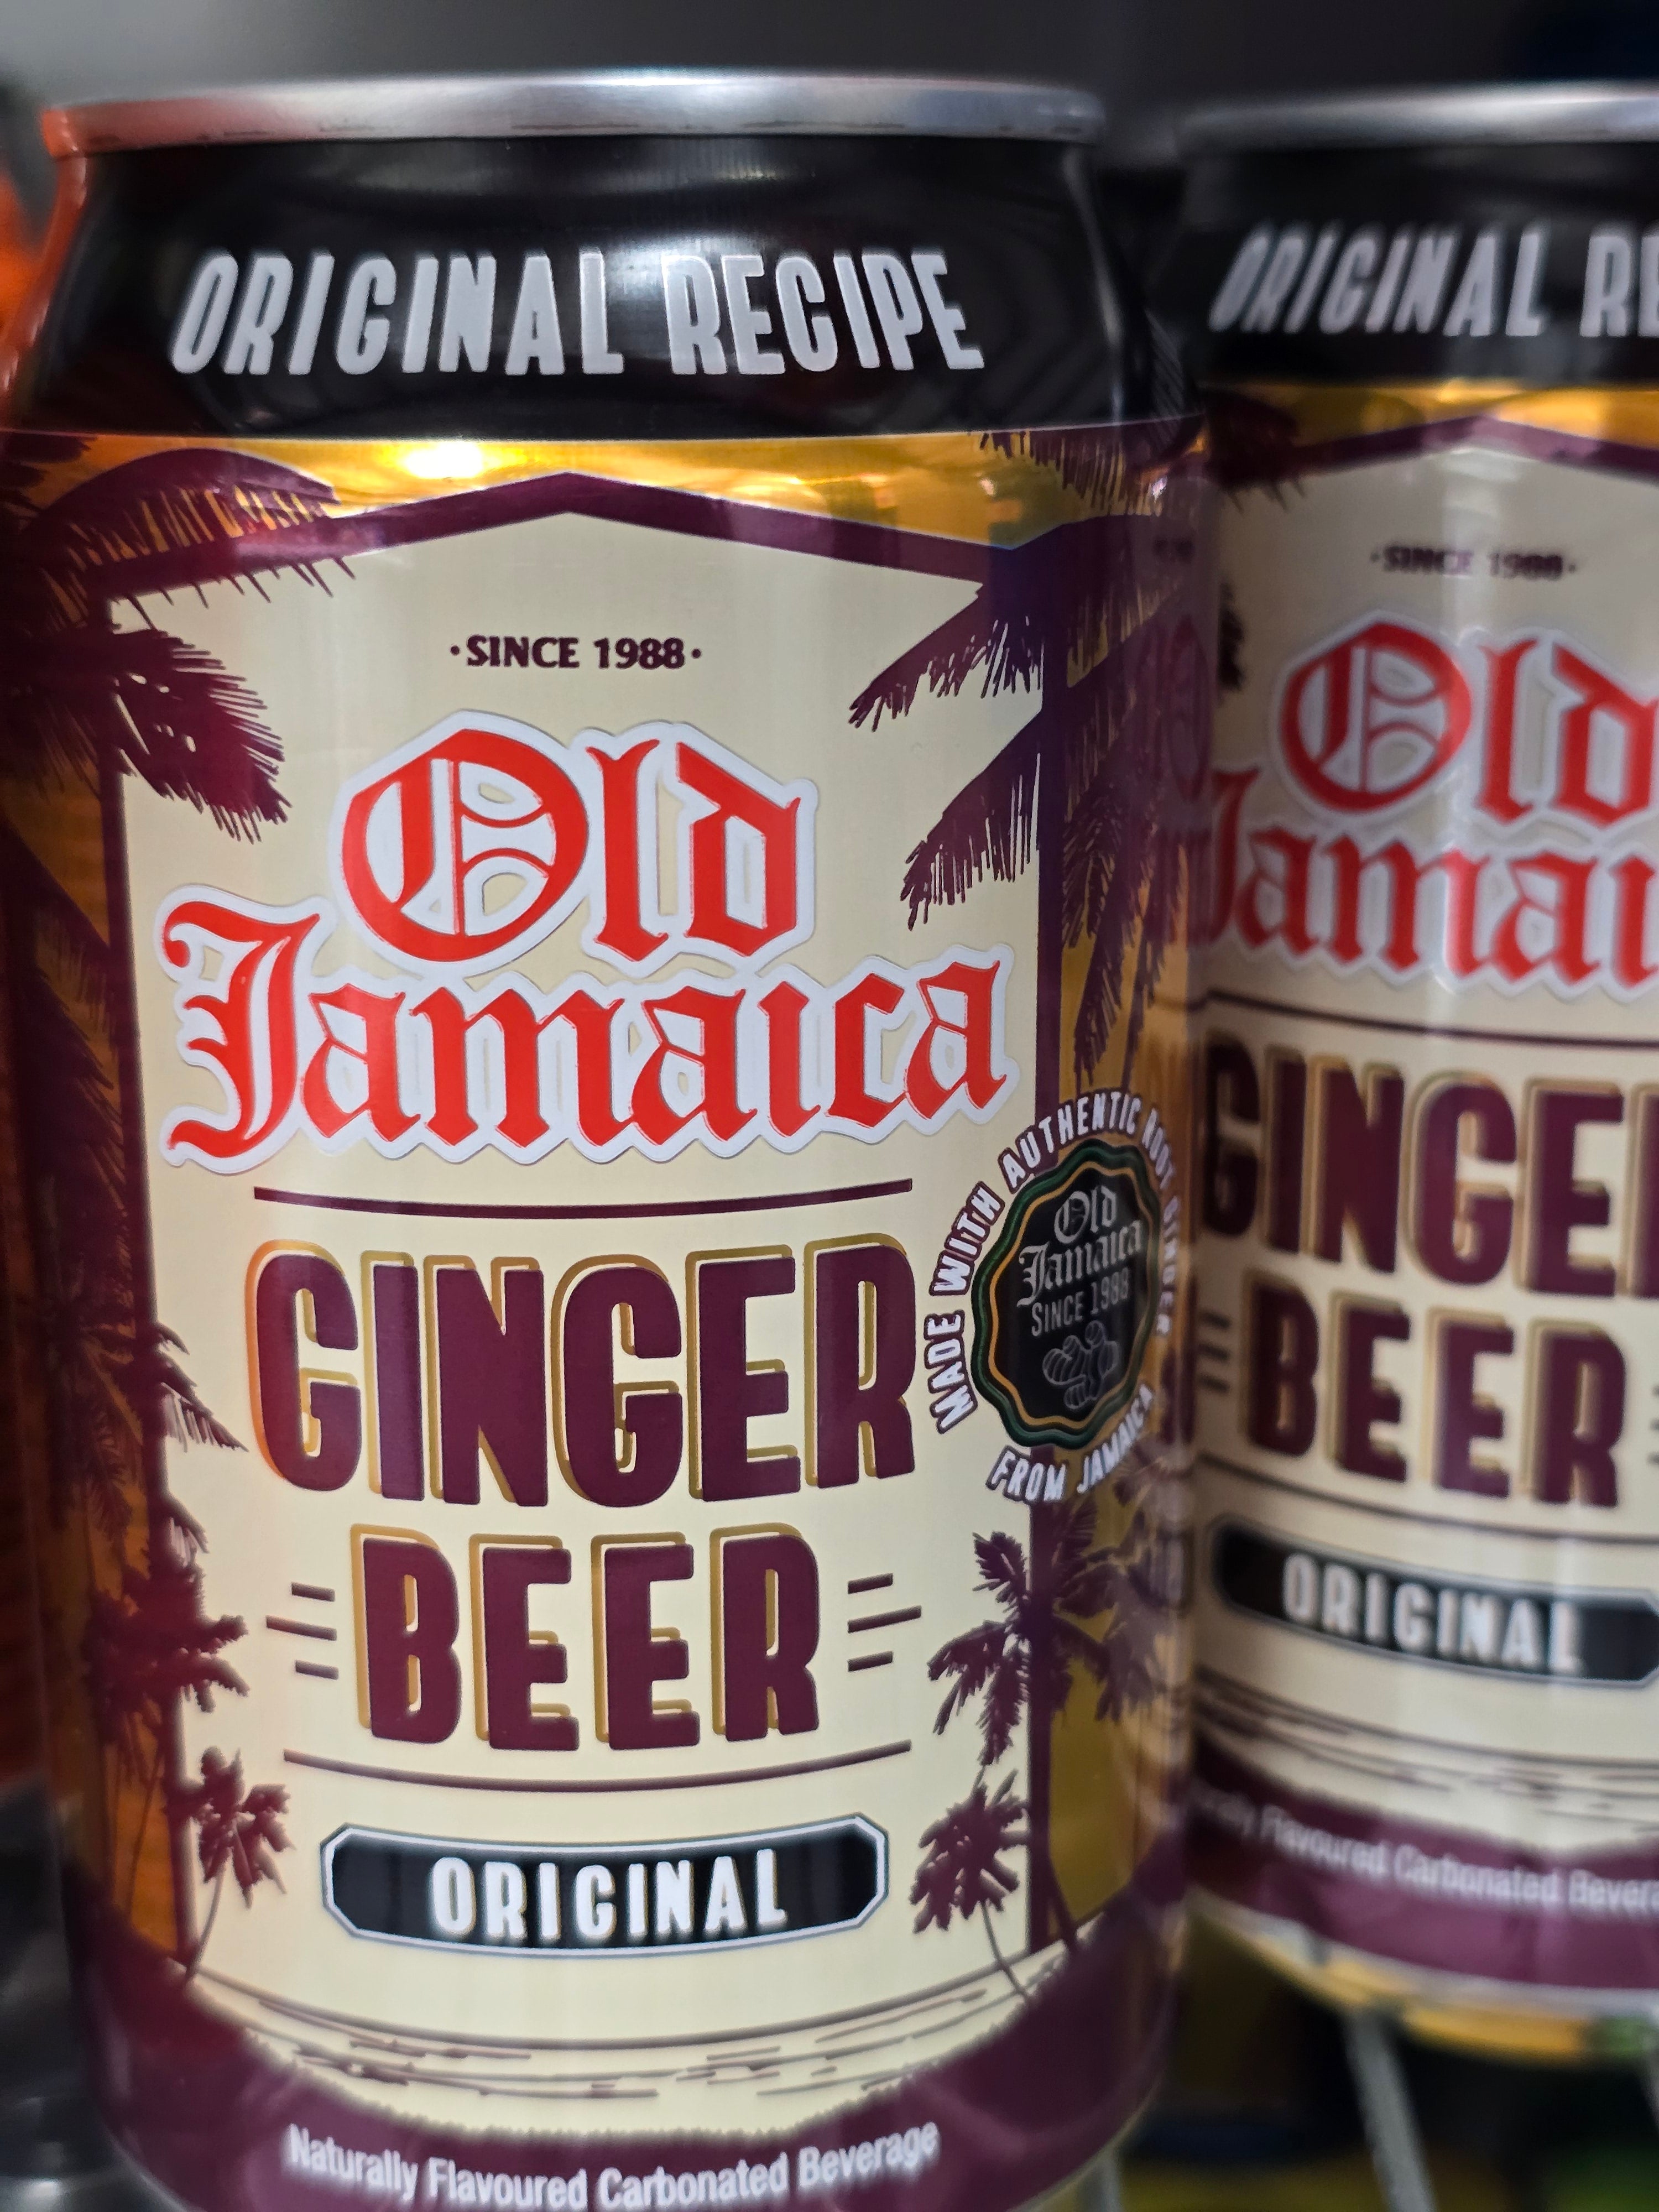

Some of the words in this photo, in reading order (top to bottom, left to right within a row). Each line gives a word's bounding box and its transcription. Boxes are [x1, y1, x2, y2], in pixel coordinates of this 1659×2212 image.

[170, 250, 624, 375] ORIGINAL
[662, 250, 985, 376] RECIPE
[1209, 226, 1547, 337] ORIGINAL
[1279, 620, 1659, 827] Old
[343, 727, 802, 963] Old
[162, 900, 1008, 1159] Jamaica
[1000, 1091, 1141, 1190] AUTHENTIC
[930, 1182, 1004, 1295] WITH
[1017, 1219, 1144, 1307] Jamaica
[1053, 1185, 1118, 1244] Old
[244, 1232, 917, 1508] GINGER
[925, 1312, 977, 1431] MADE
[1030, 1291, 1084, 1337] SINCE
[990, 1449, 1067, 1501] FROM
[1077, 1384, 1153, 1493] JAMAICA
[1243, 1269, 1627, 1507] BEER
[349, 1522, 821, 1751] BEER
[1282, 1553, 1584, 1676] ORIGINAL
[430, 1848, 788, 1940] ORIGINAL
[286, 2123, 419, 2203] Naturally
[426, 2157, 588, 2210] Flavoured
[597, 2151, 790, 2210] Carbonated
[797, 2121, 940, 2189] Beverage
